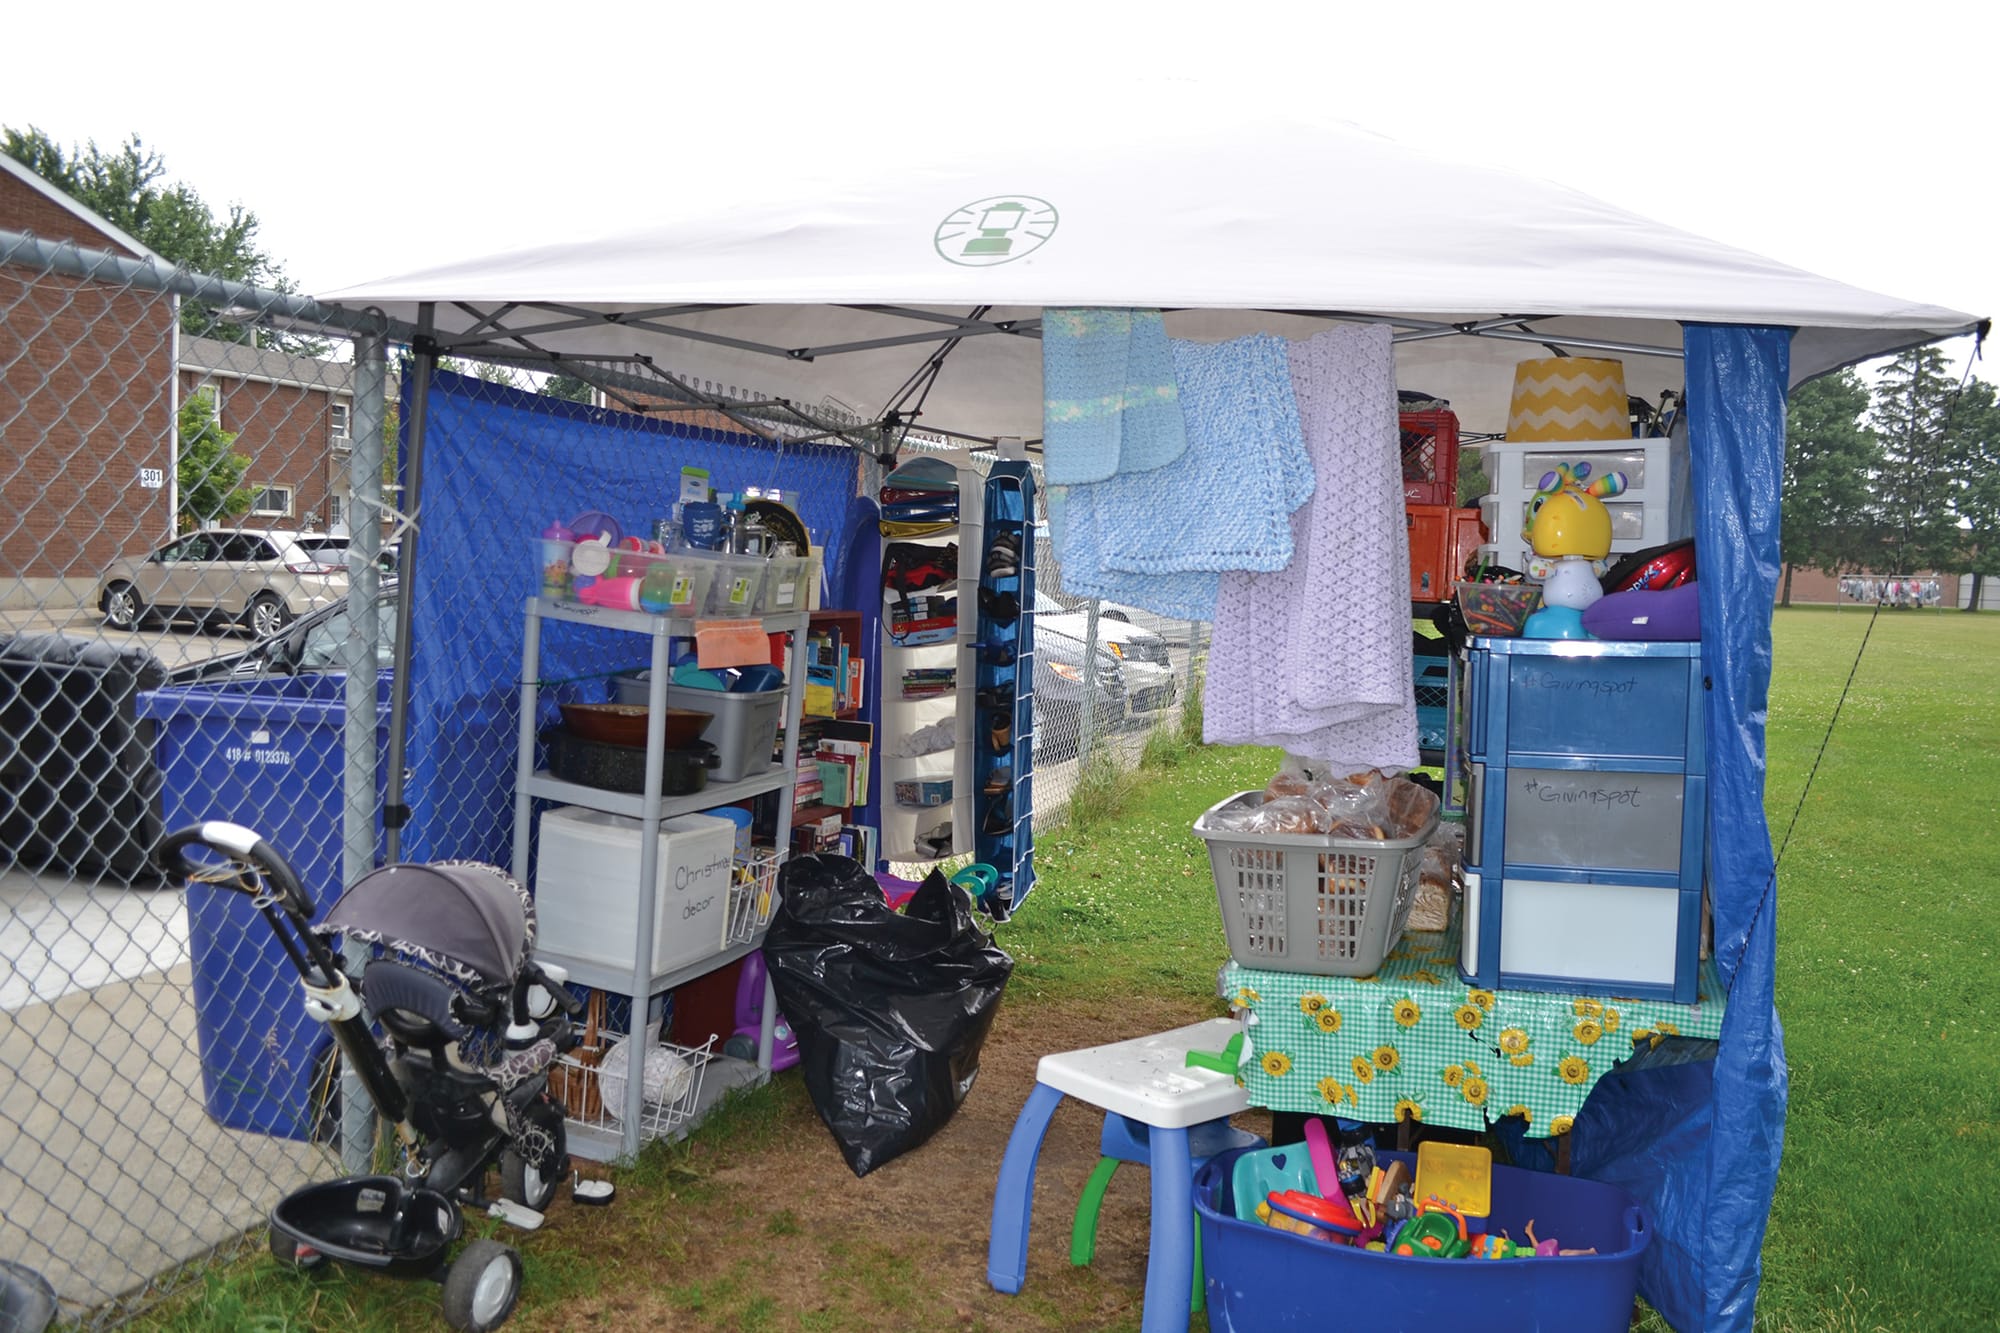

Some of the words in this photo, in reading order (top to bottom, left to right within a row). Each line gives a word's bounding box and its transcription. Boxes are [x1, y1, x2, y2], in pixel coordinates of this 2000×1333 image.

[144, 470, 161, 482] 301
[1524, 778, 1641, 810] #Givingspot
[682, 895, 715, 920] decor
